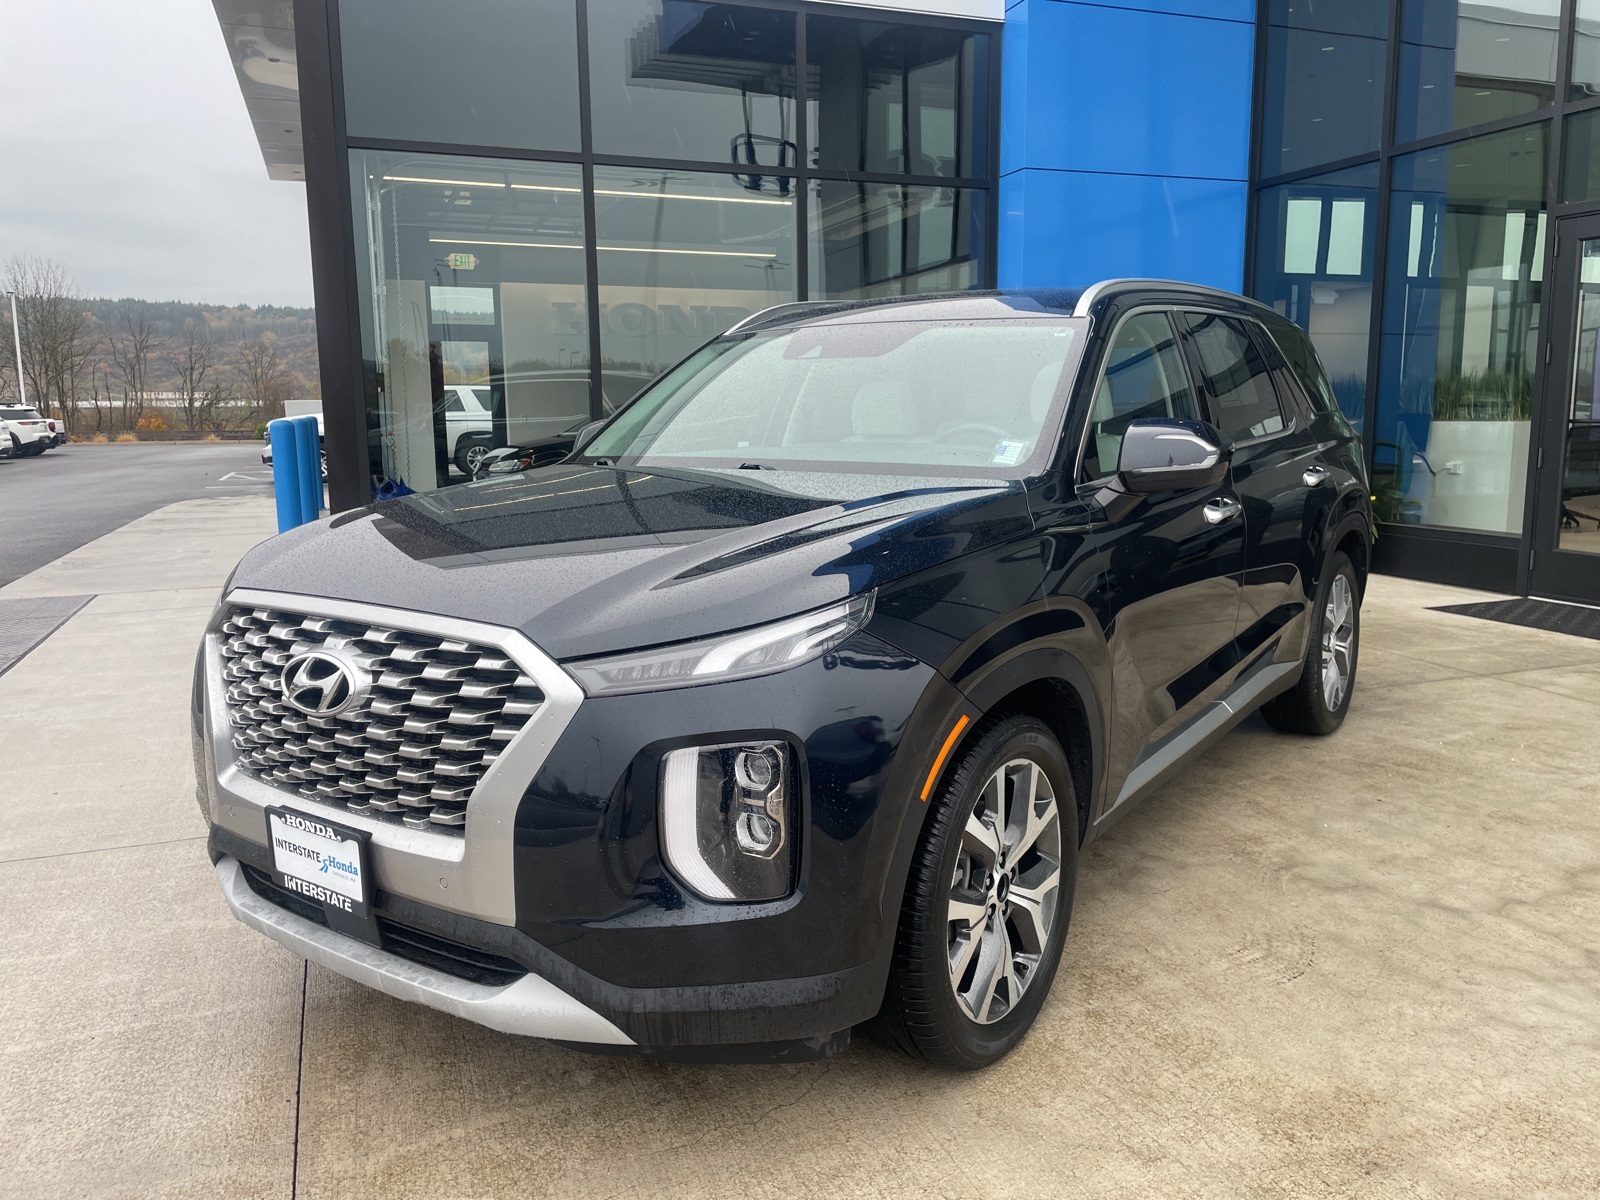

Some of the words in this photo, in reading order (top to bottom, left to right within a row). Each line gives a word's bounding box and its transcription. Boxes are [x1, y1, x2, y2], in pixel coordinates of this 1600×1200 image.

[454, 254, 471, 267] EXIT
[552, 302, 757, 337] HOND
[285, 814, 338, 840] HONDA
[275, 837, 321, 863] INTERSTATE
[328, 855, 359, 876] Honda
[284, 874, 353, 912] INTERSTATE
